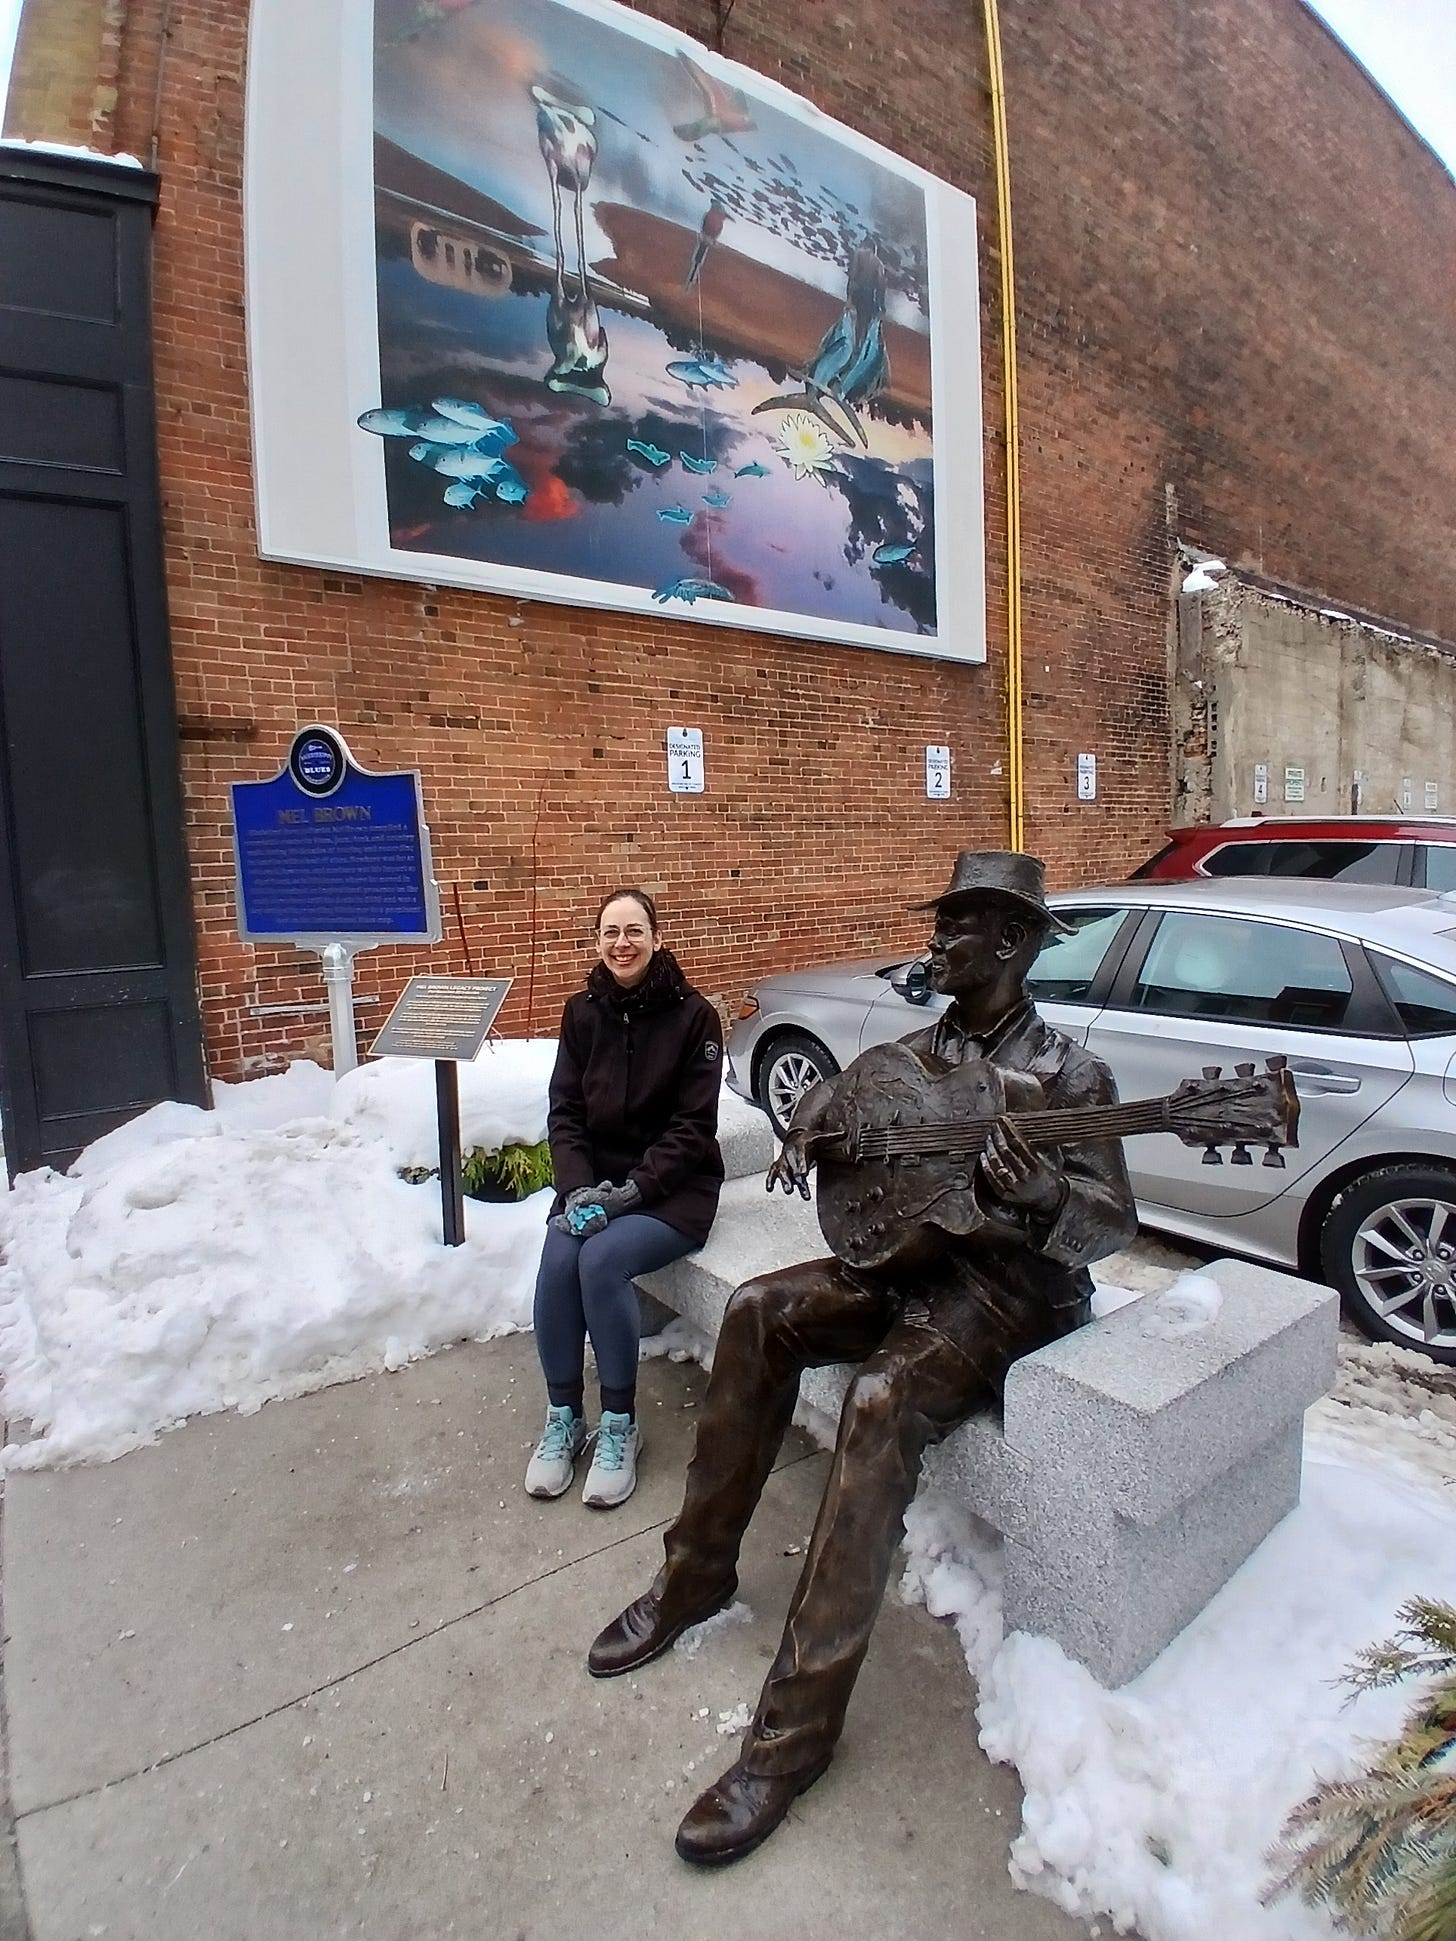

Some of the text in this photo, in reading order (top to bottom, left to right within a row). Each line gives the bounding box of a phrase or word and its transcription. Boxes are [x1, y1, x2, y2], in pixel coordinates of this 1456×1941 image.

[669, 750, 701, 758] PARKING
[682, 760, 691, 779] 1
[935, 772, 942, 788] 2
[1084, 776, 1090, 790] 3
[279, 806, 371, 823] MEL BROWN
